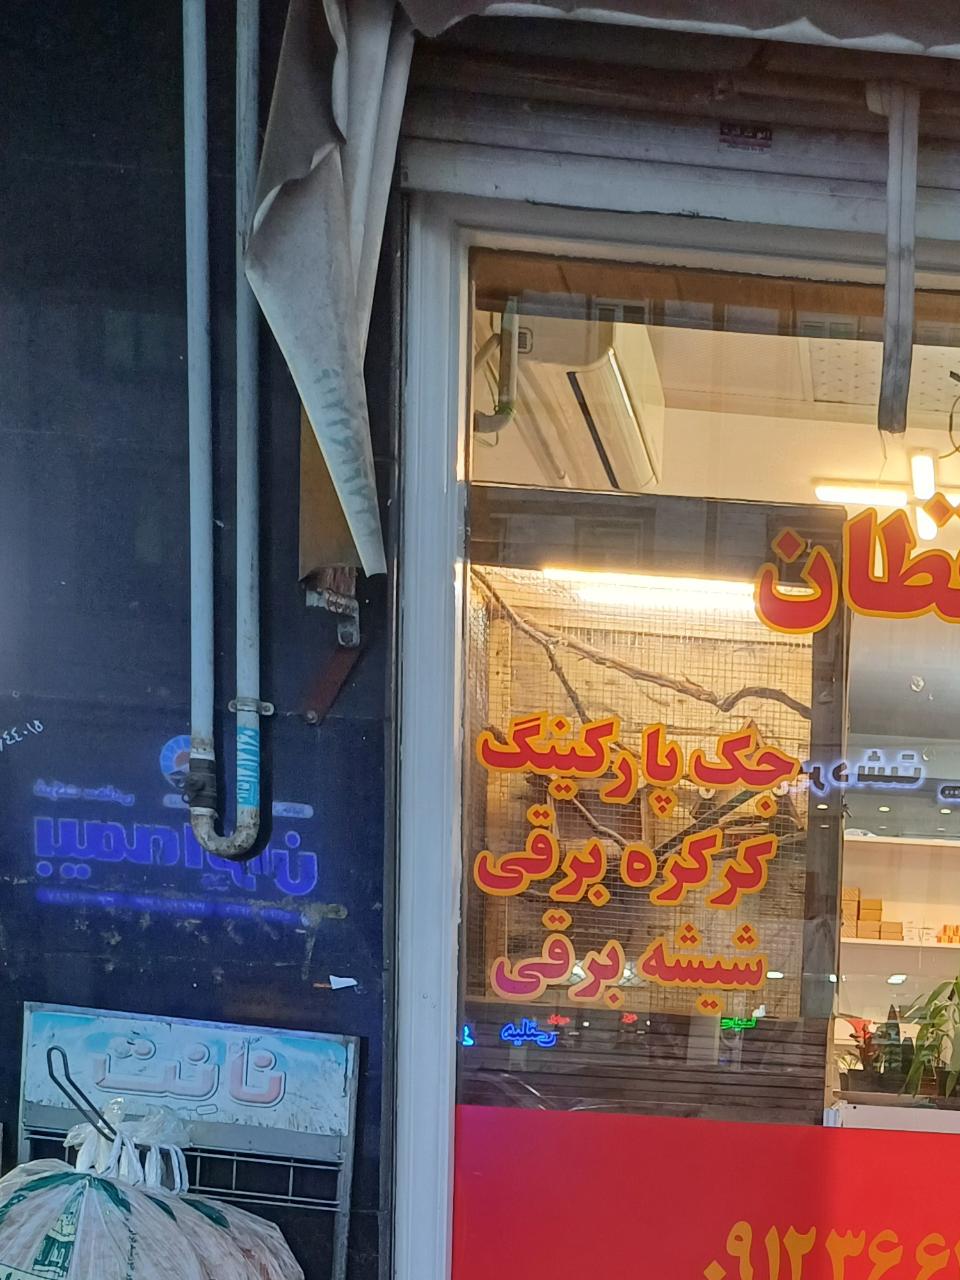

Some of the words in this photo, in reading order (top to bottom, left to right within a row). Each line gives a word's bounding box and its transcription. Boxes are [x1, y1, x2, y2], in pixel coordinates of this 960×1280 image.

[477, 712, 685, 818] پارکینگ
[689, 729, 801, 819] جک
[474, 805, 612, 906] برقی
[620, 828, 778, 910] کرکره
[491, 908, 626, 1008] برقی
[638, 921, 769, 1014] شیشه
